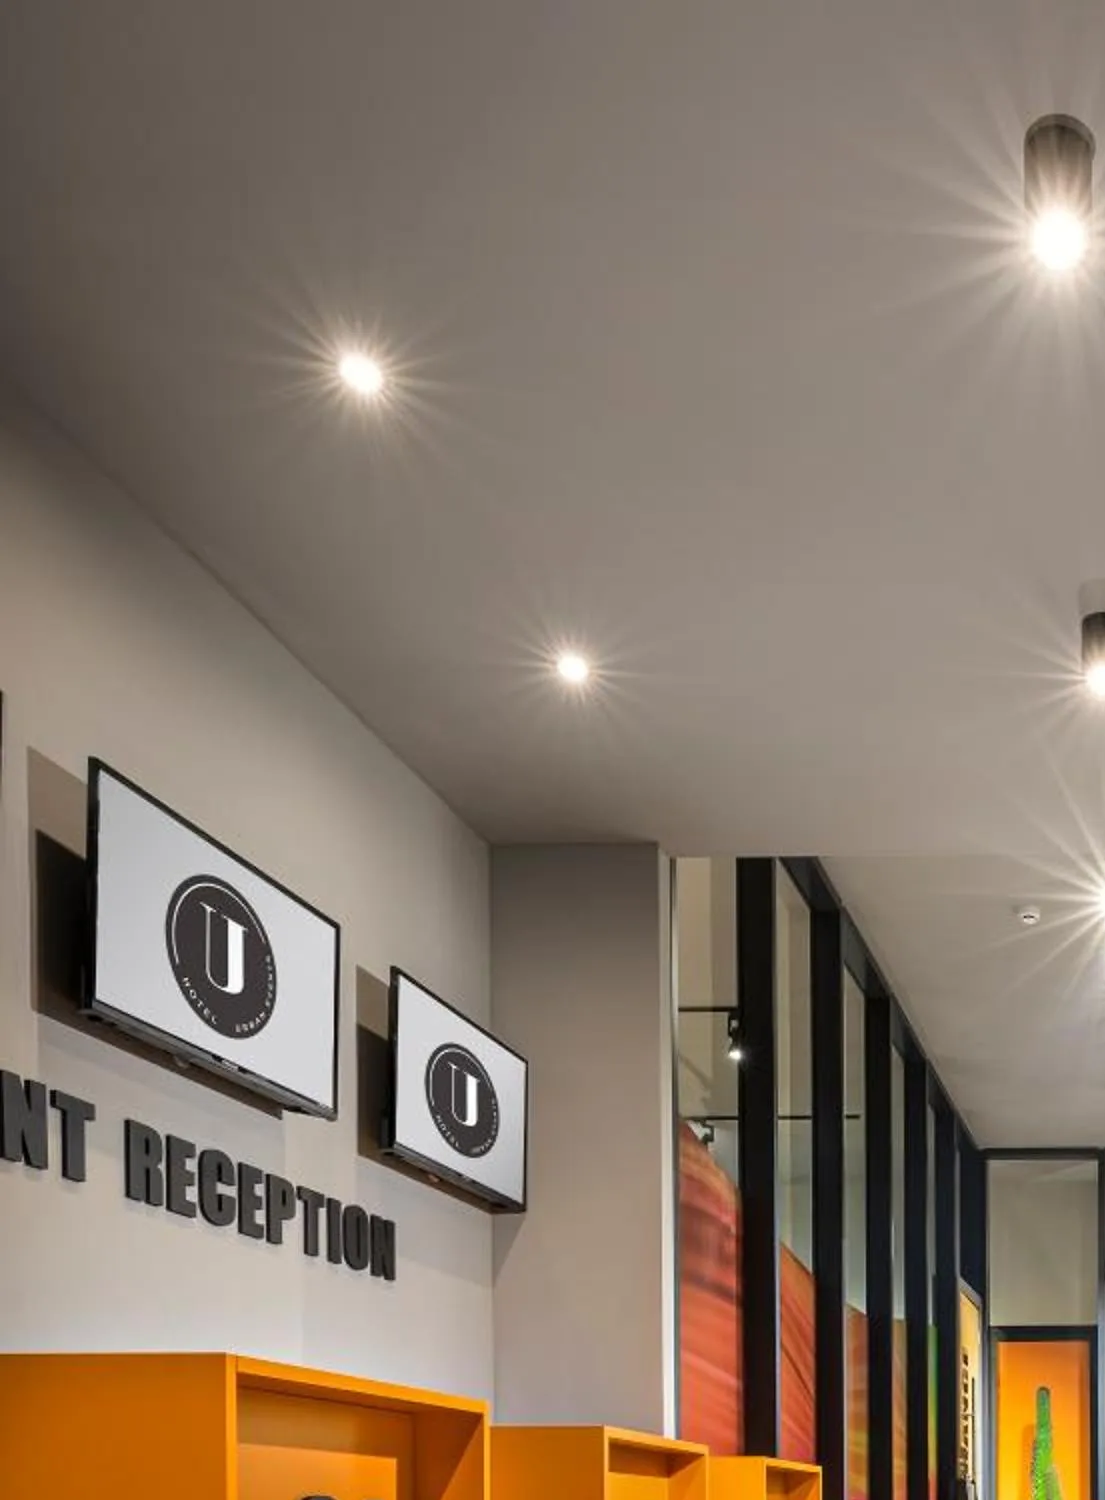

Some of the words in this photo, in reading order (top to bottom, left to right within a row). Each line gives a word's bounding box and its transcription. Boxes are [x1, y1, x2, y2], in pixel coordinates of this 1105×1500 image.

[199, 901, 249, 995] U
[183, 976, 218, 1025] HOTEL
[448, 1061, 480, 1127] U
[124, 1118, 396, 1281] RECEPTION
